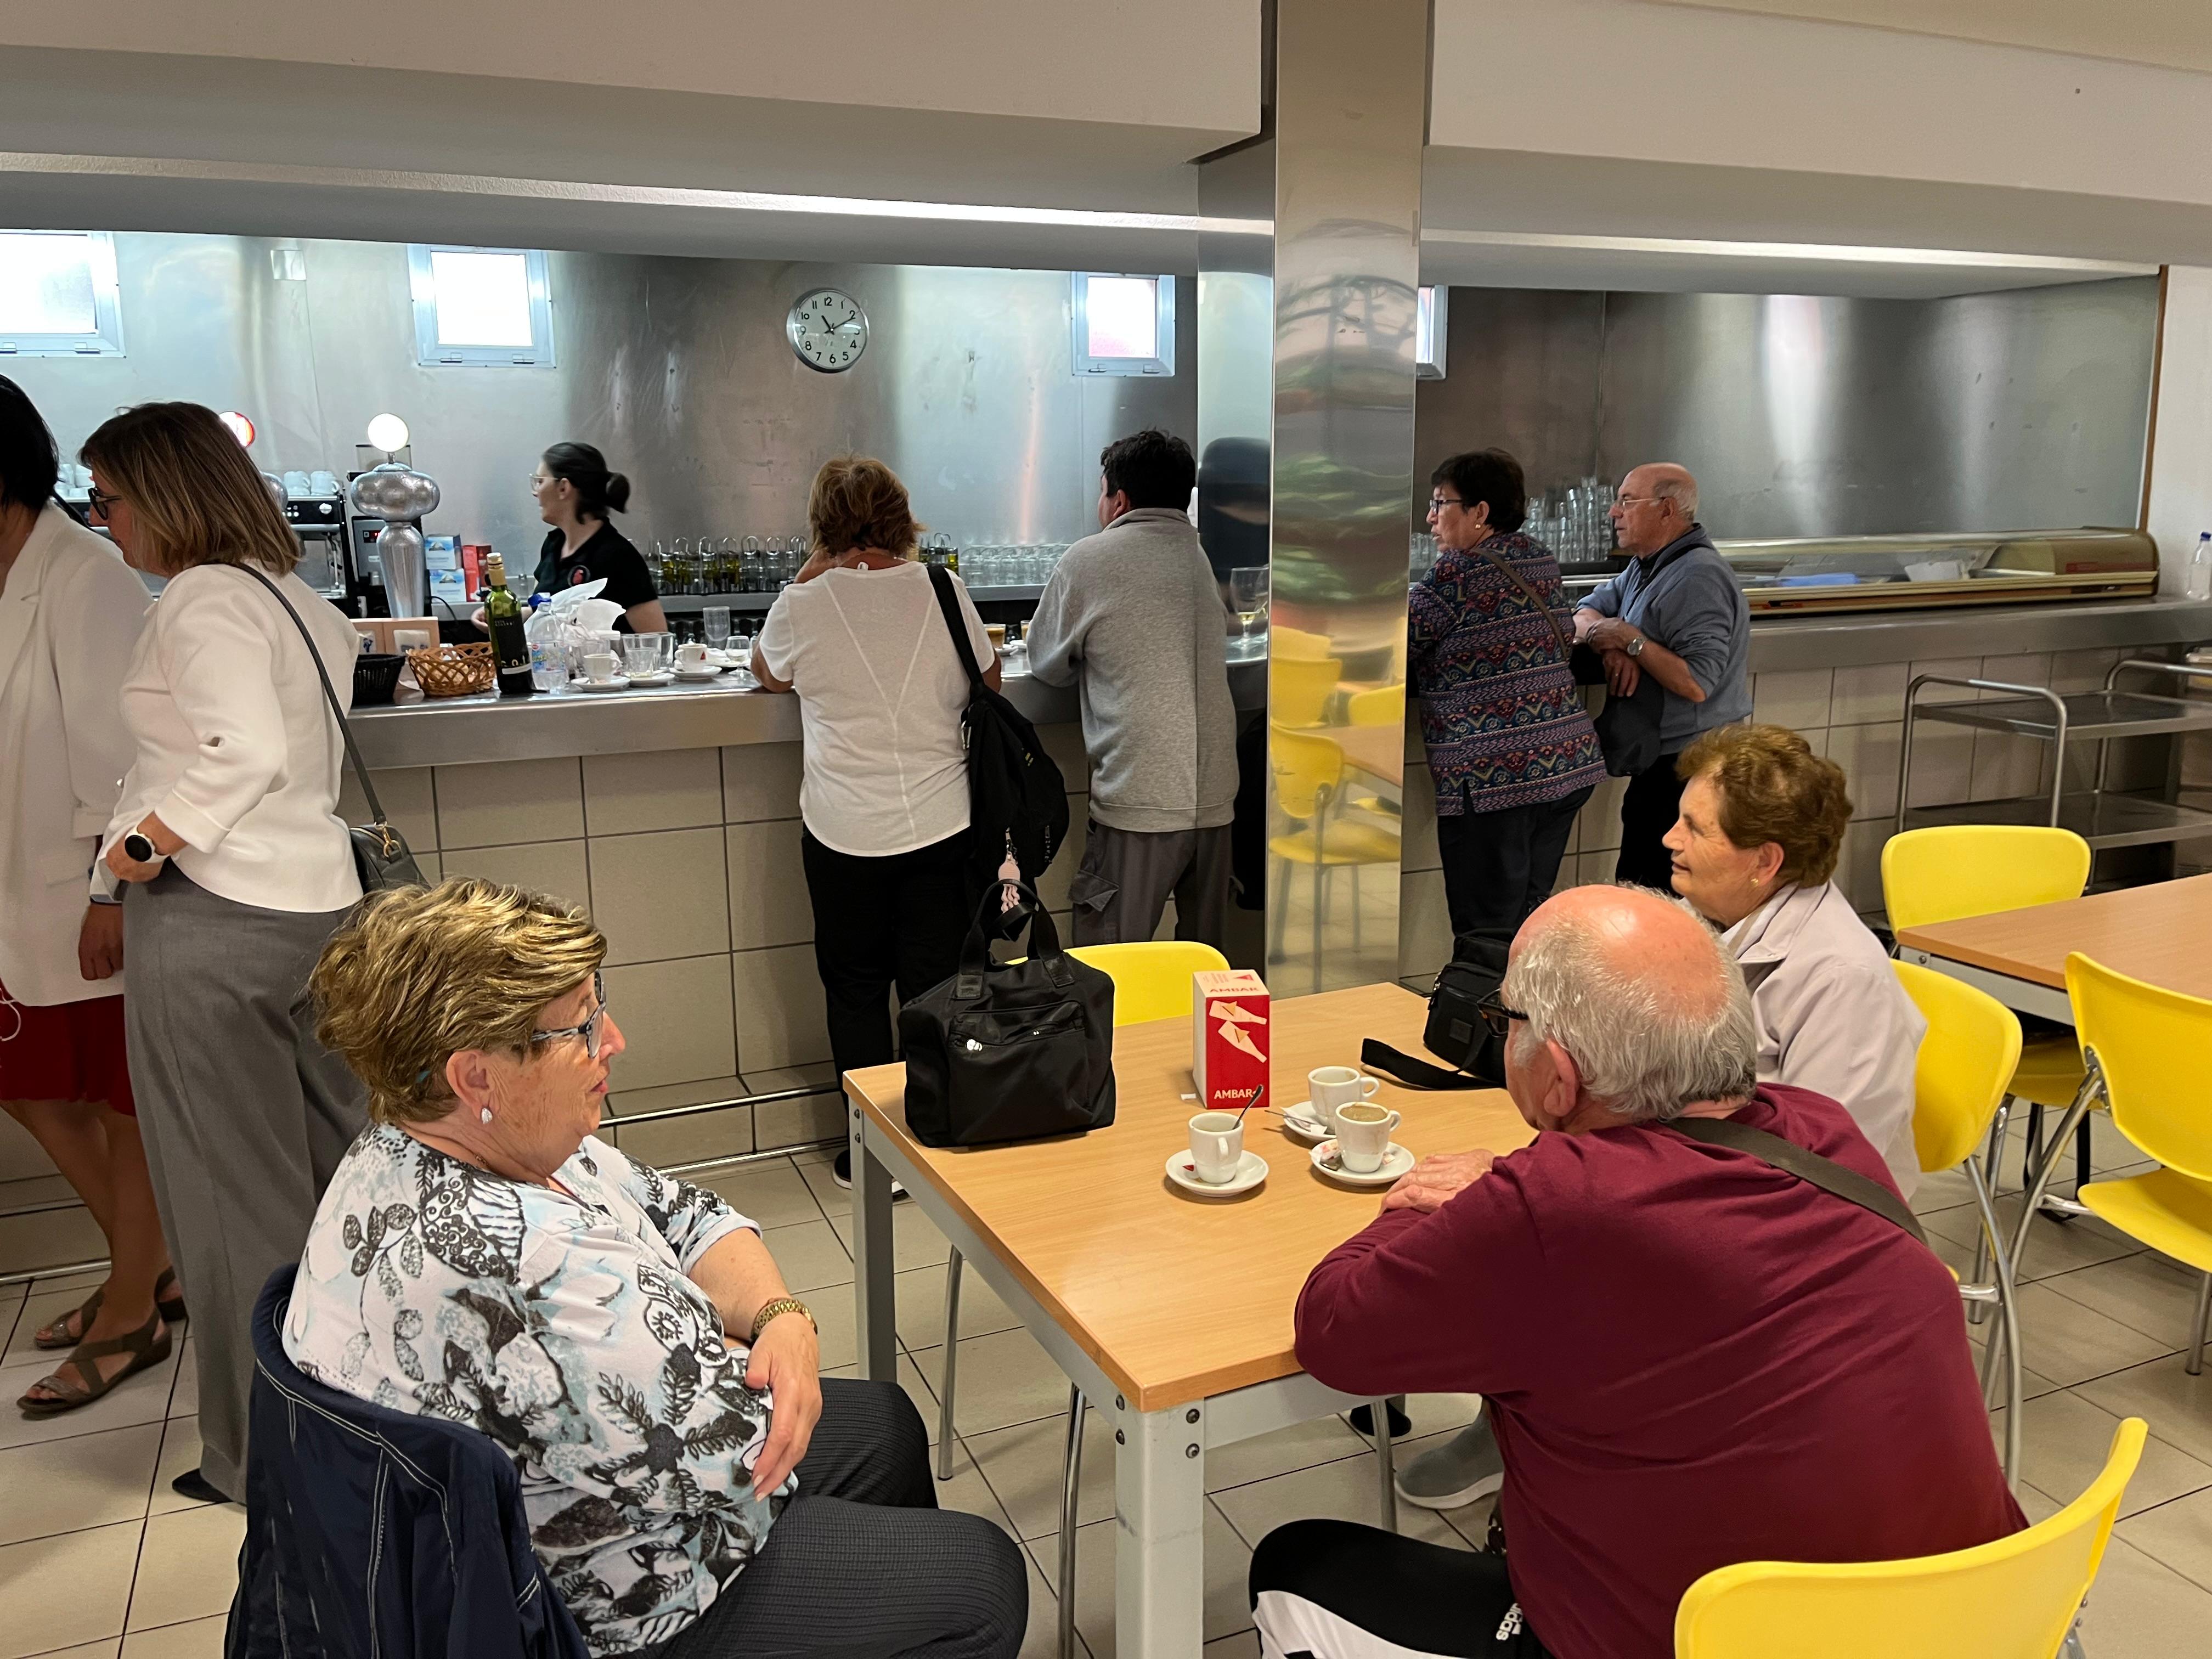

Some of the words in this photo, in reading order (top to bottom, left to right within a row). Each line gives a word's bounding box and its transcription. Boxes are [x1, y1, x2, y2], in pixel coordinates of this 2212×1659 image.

[812, 301, 817, 309] 11
[824, 297, 832, 306] 12
[841, 301, 843, 309] 1
[849, 311, 855, 319] 2
[800, 326, 806, 335] 9
[805, 341, 812, 351] 8
[850, 340, 856, 348] 4
[816, 352, 822, 361] 7
[830, 354, 836, 364] 6
[843, 352, 849, 360] 5
[1214, 1089, 1254, 1099] AMBAR
[1496, 1602, 1522, 1640] idas
